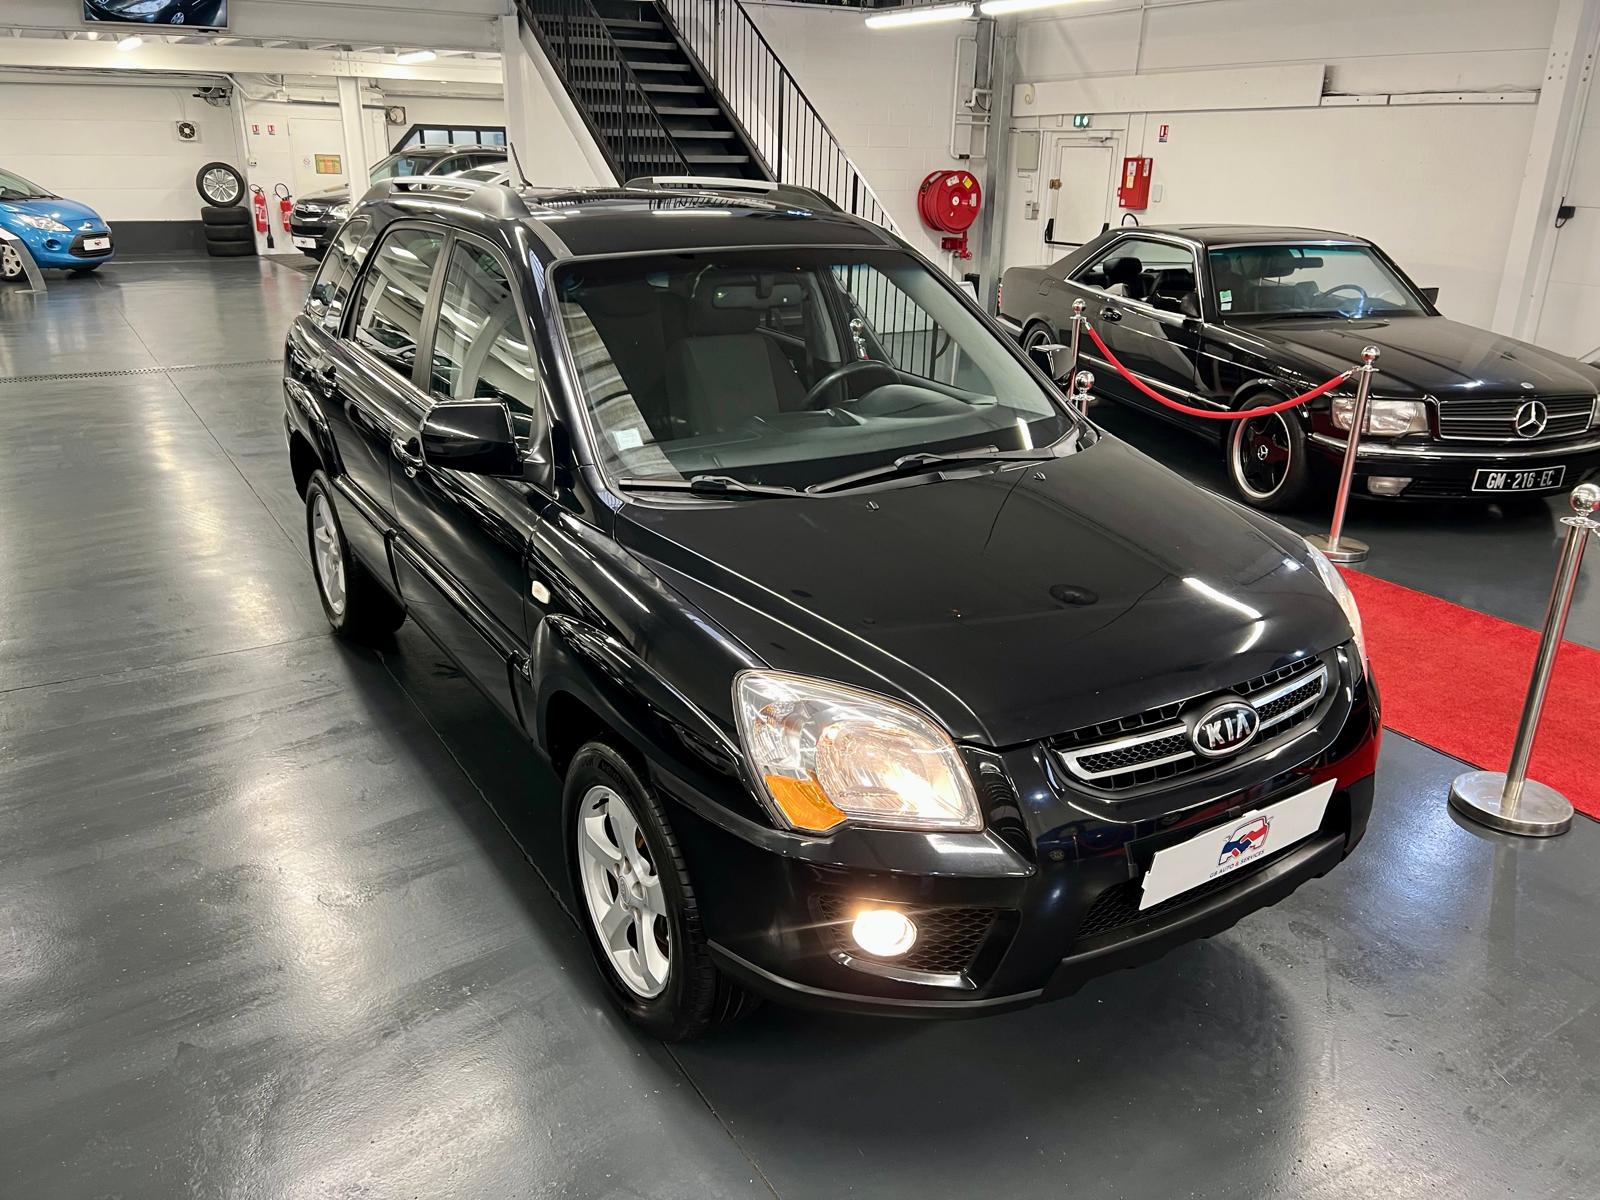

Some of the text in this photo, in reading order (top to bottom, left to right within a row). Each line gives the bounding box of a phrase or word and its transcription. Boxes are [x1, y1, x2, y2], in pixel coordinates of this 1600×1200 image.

[1203, 711, 1252, 748] KIA
[1219, 864, 1234, 873] AUTO
[1240, 850, 1264, 864] SERVICES
